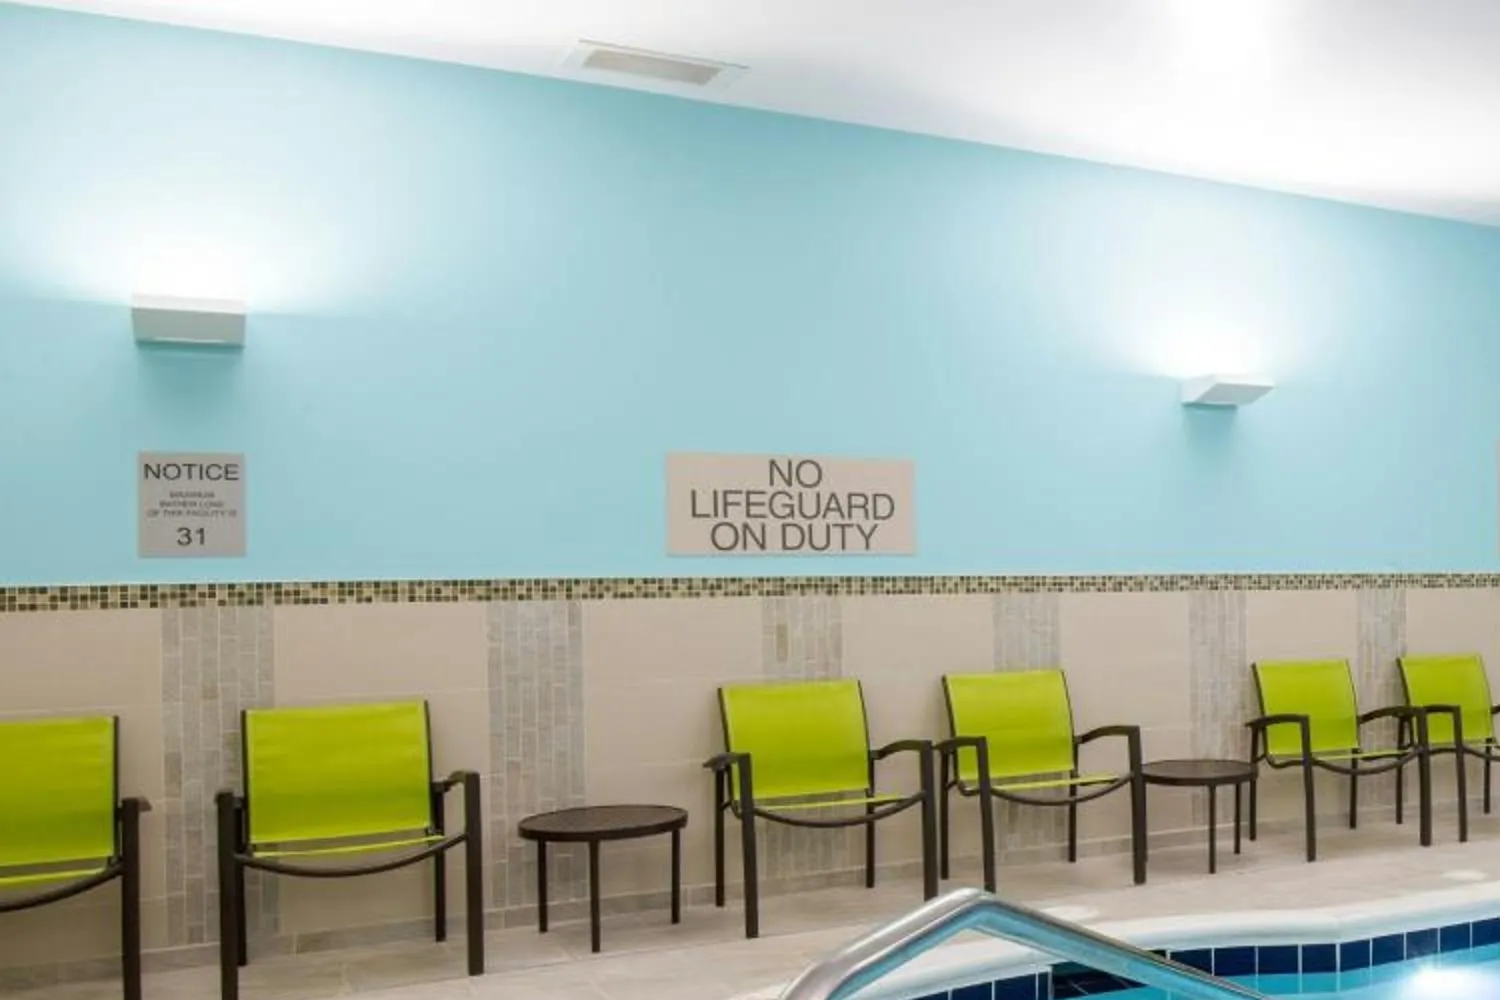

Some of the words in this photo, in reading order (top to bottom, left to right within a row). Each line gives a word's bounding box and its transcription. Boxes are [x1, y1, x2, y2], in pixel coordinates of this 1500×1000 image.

[143, 463, 240, 481] NOTICE
[768, 458, 823, 488] NO
[690, 489, 895, 520] LIFEGUARD
[176, 527, 205, 546] 31
[711, 521, 766, 551] ON
[781, 522, 878, 551] DUTY
